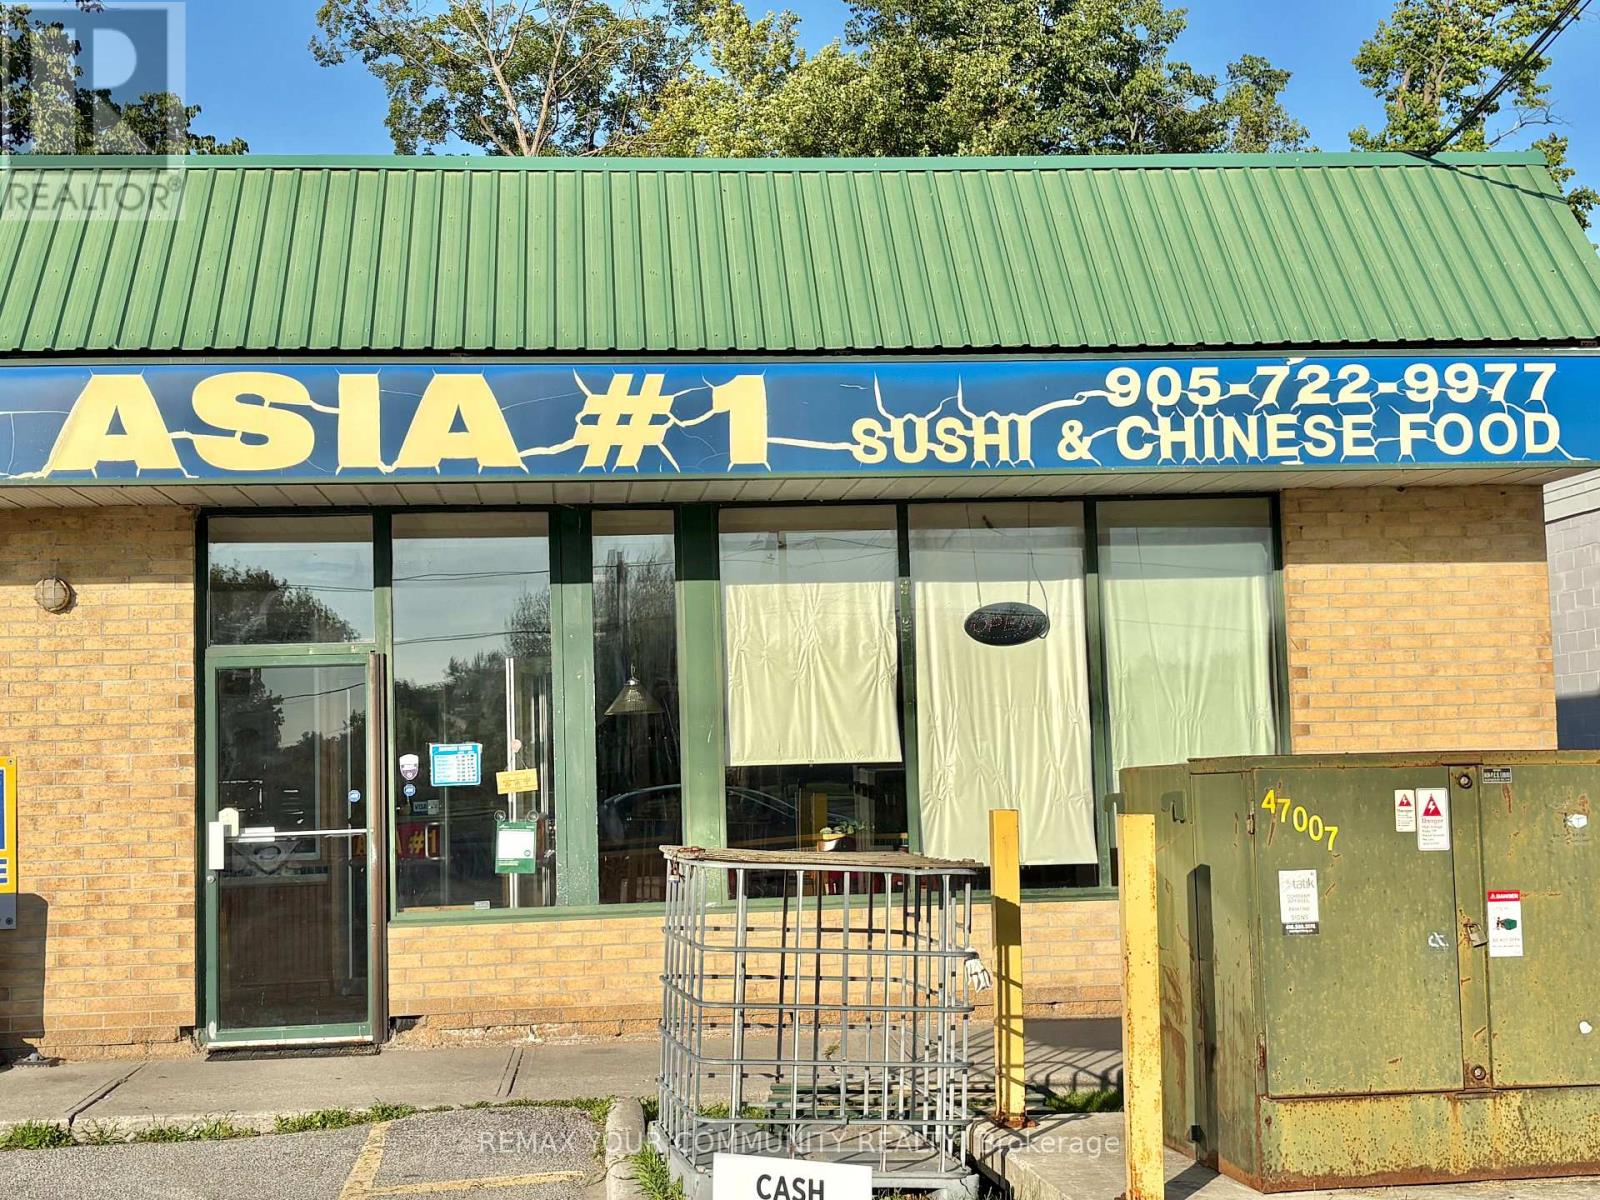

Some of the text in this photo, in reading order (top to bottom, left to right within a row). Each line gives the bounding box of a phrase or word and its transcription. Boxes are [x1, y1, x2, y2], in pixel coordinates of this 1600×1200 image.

[1105, 362, 1557, 407] 905-722-9977
[48, 370, 769, 471] ASIA #1
[850, 411, 1561, 465] SUSHI & CHINESE FOOD
[1261, 789, 1340, 851] 47007
[756, 1173, 825, 1200] CASH
